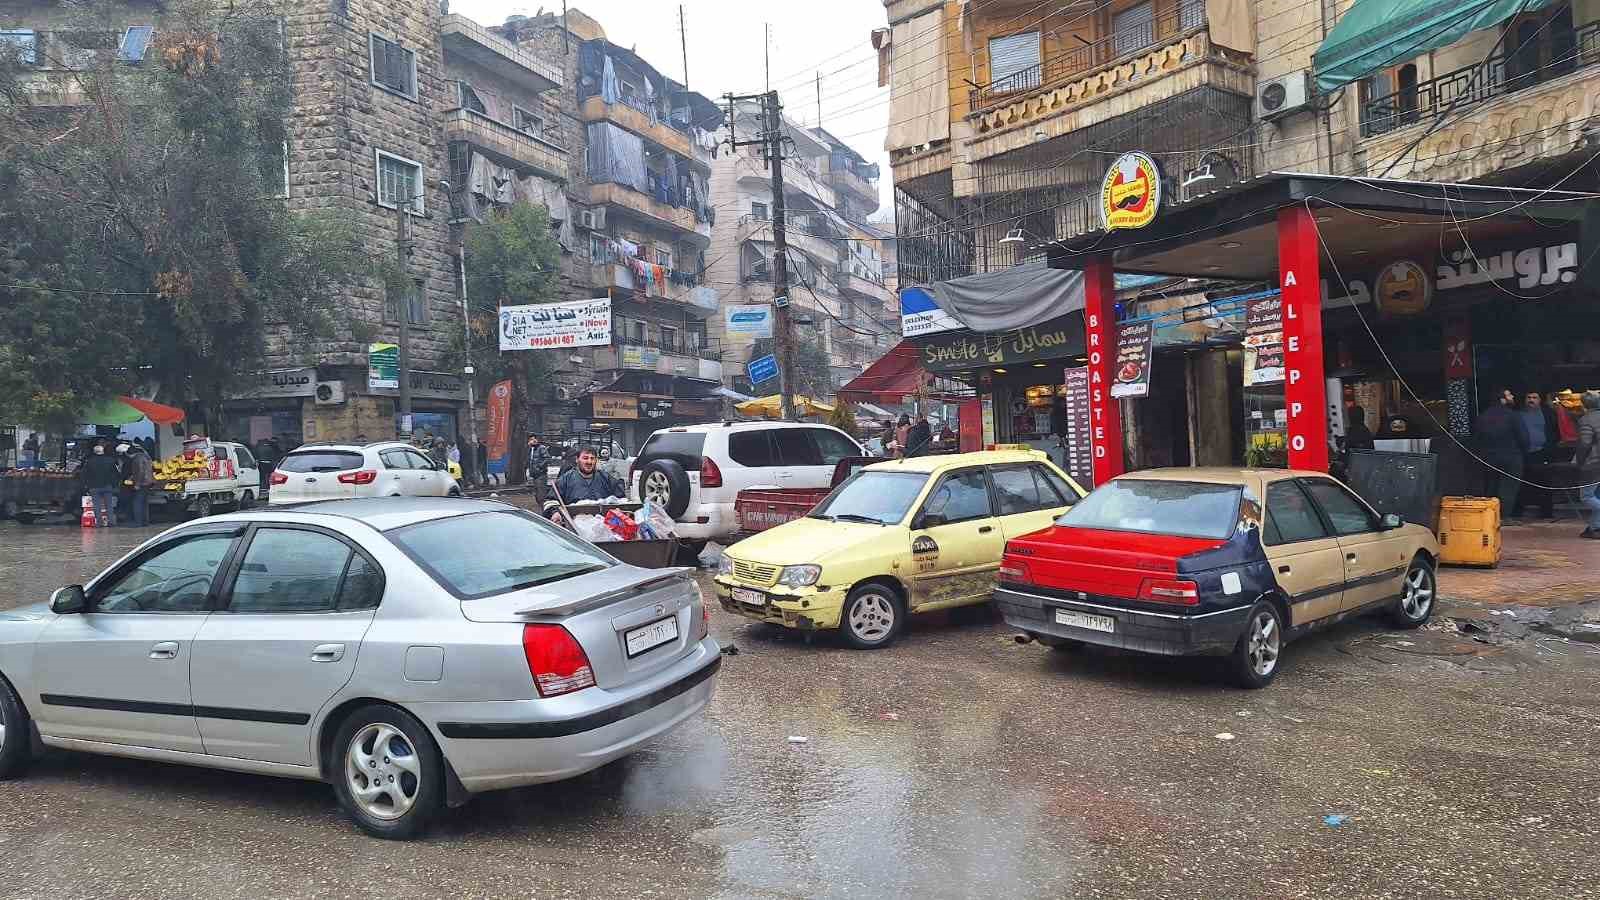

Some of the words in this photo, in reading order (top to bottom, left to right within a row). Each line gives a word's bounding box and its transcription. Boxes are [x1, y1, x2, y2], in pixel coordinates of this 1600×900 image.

[1436, 242, 1577, 291] بروستد
[1320, 278, 1371, 310] حل
[512, 316, 526, 326] SIA
[512, 326, 526, 336] NET
[1283, 270, 1305, 451] ALEPPO
[1089, 315, 1105, 458] BROASTED
[913, 541, 935, 550] TAXI
